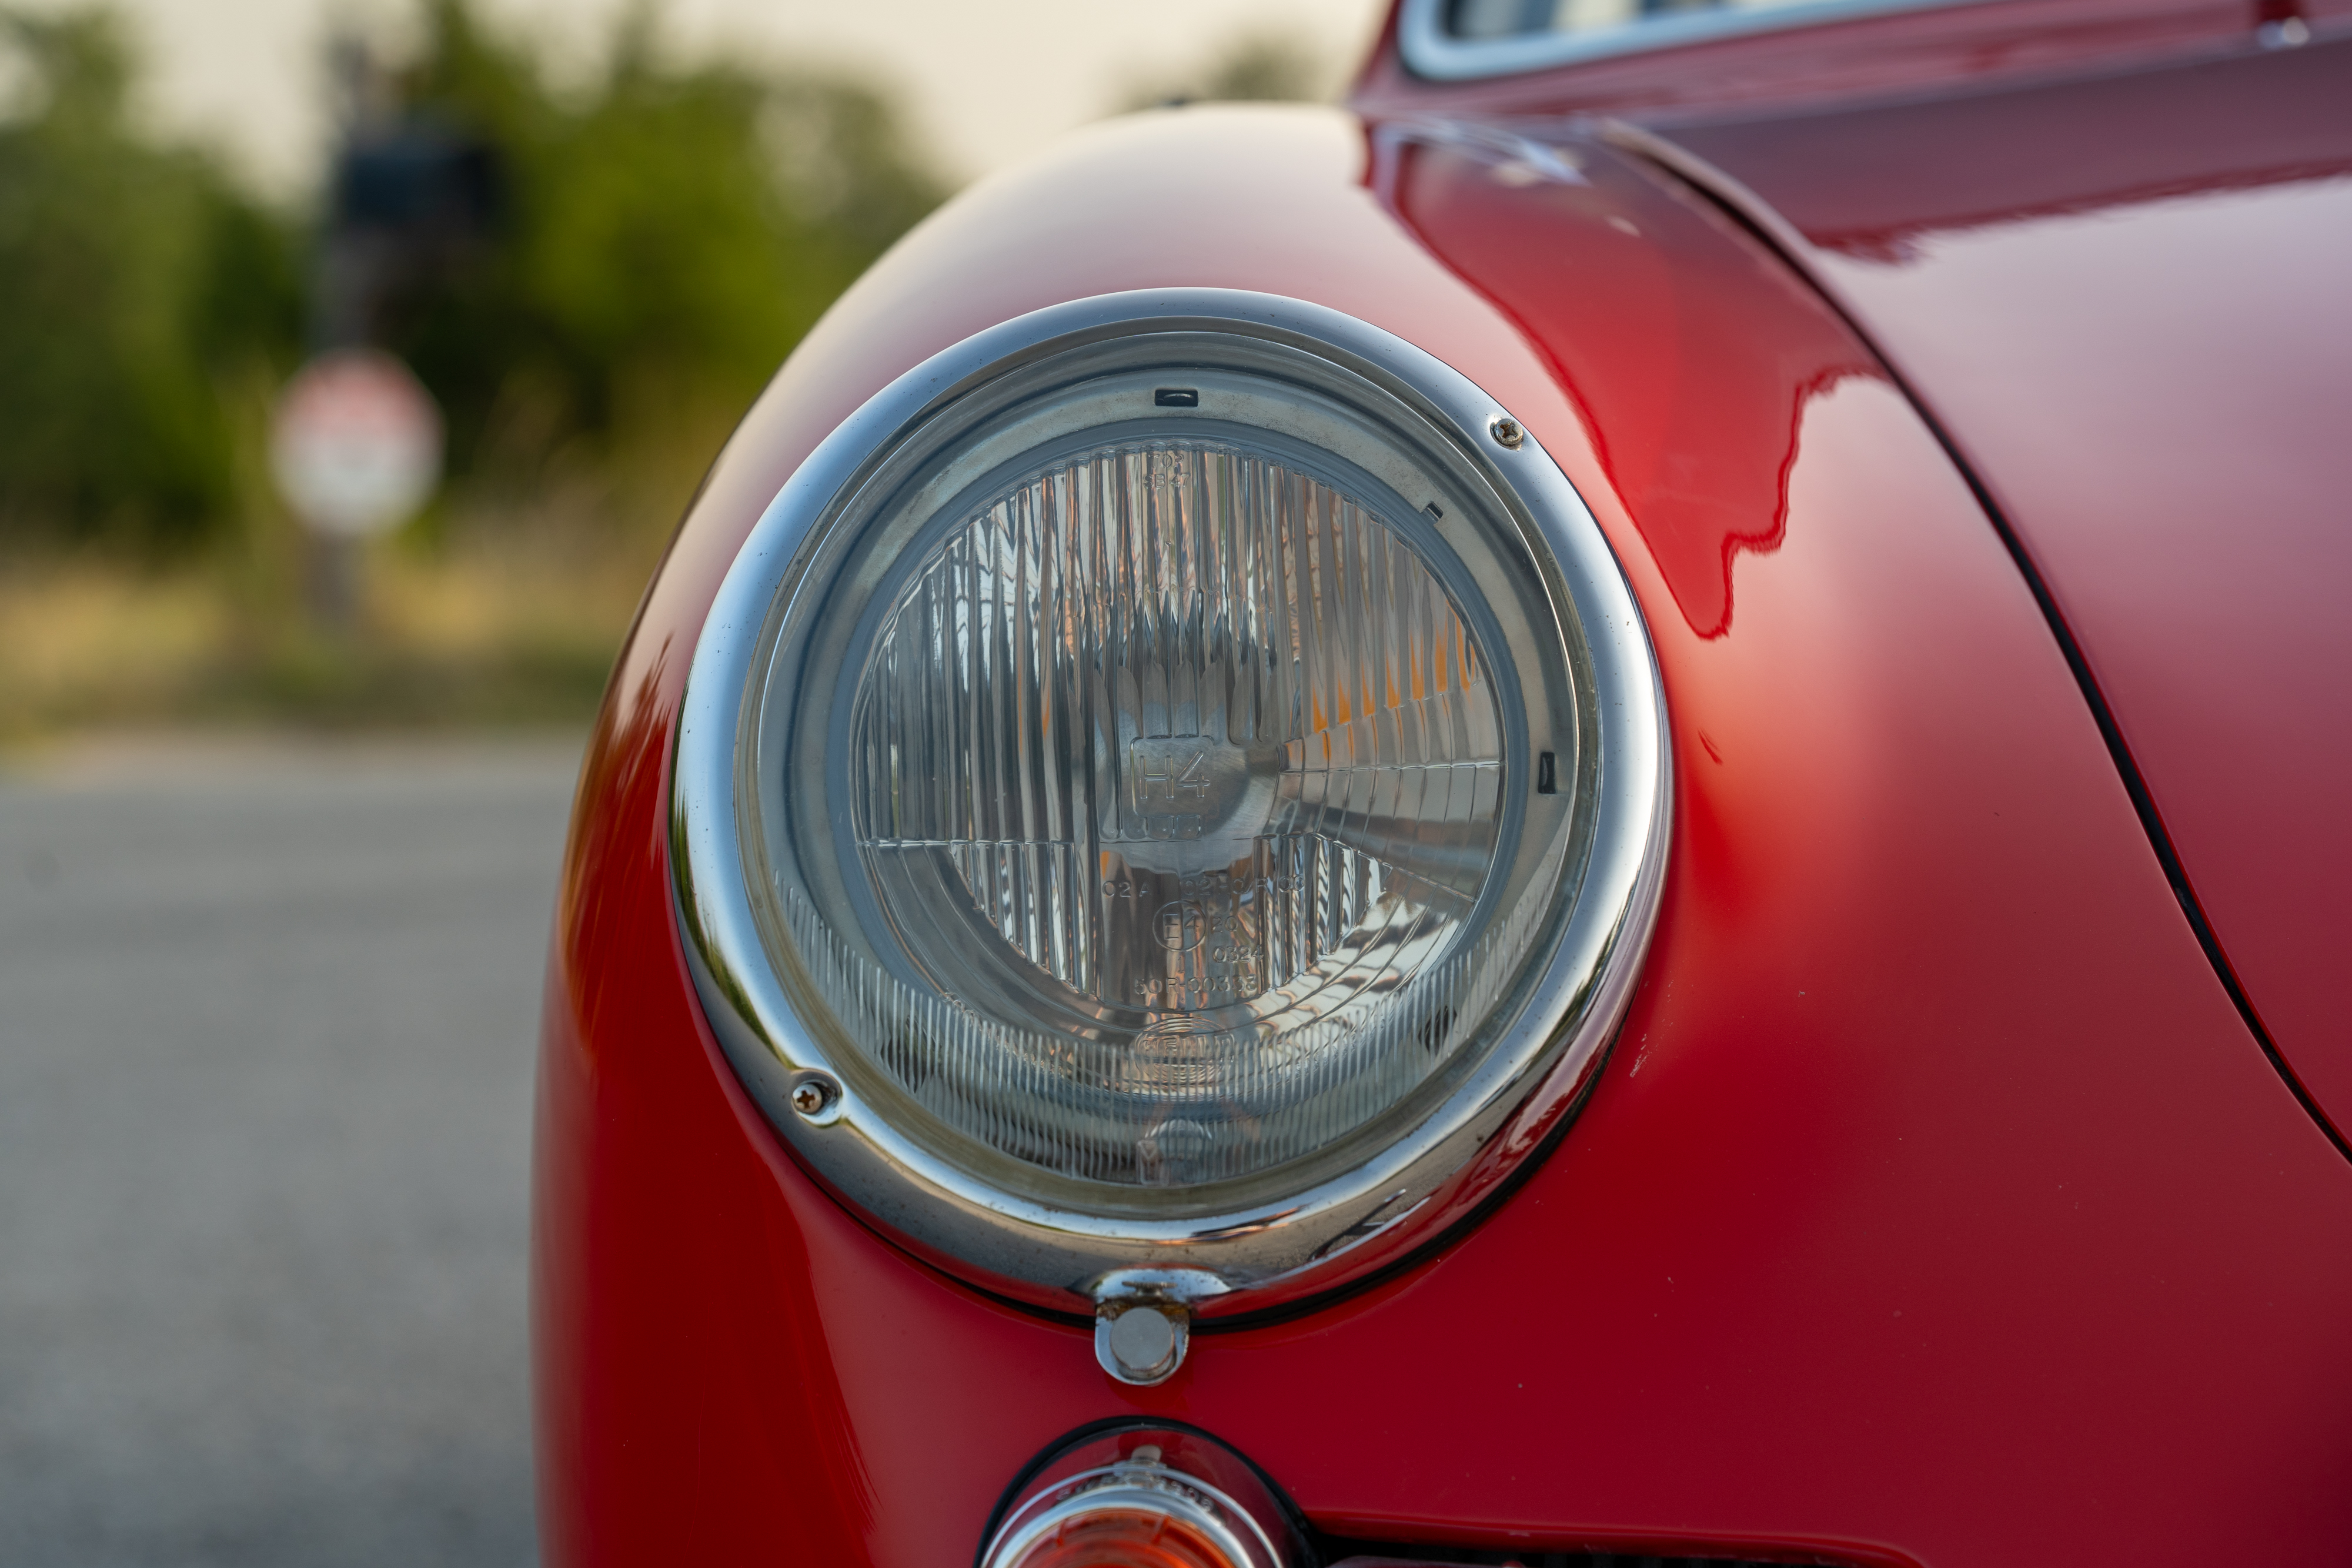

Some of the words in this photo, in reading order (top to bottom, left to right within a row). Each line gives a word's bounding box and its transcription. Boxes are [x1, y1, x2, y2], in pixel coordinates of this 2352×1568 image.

[1140, 750, 1210, 800] H4
[1139, 882, 1151, 897] A
[1211, 915, 1238, 934] 20
[1213, 945, 1264, 963] 0324
